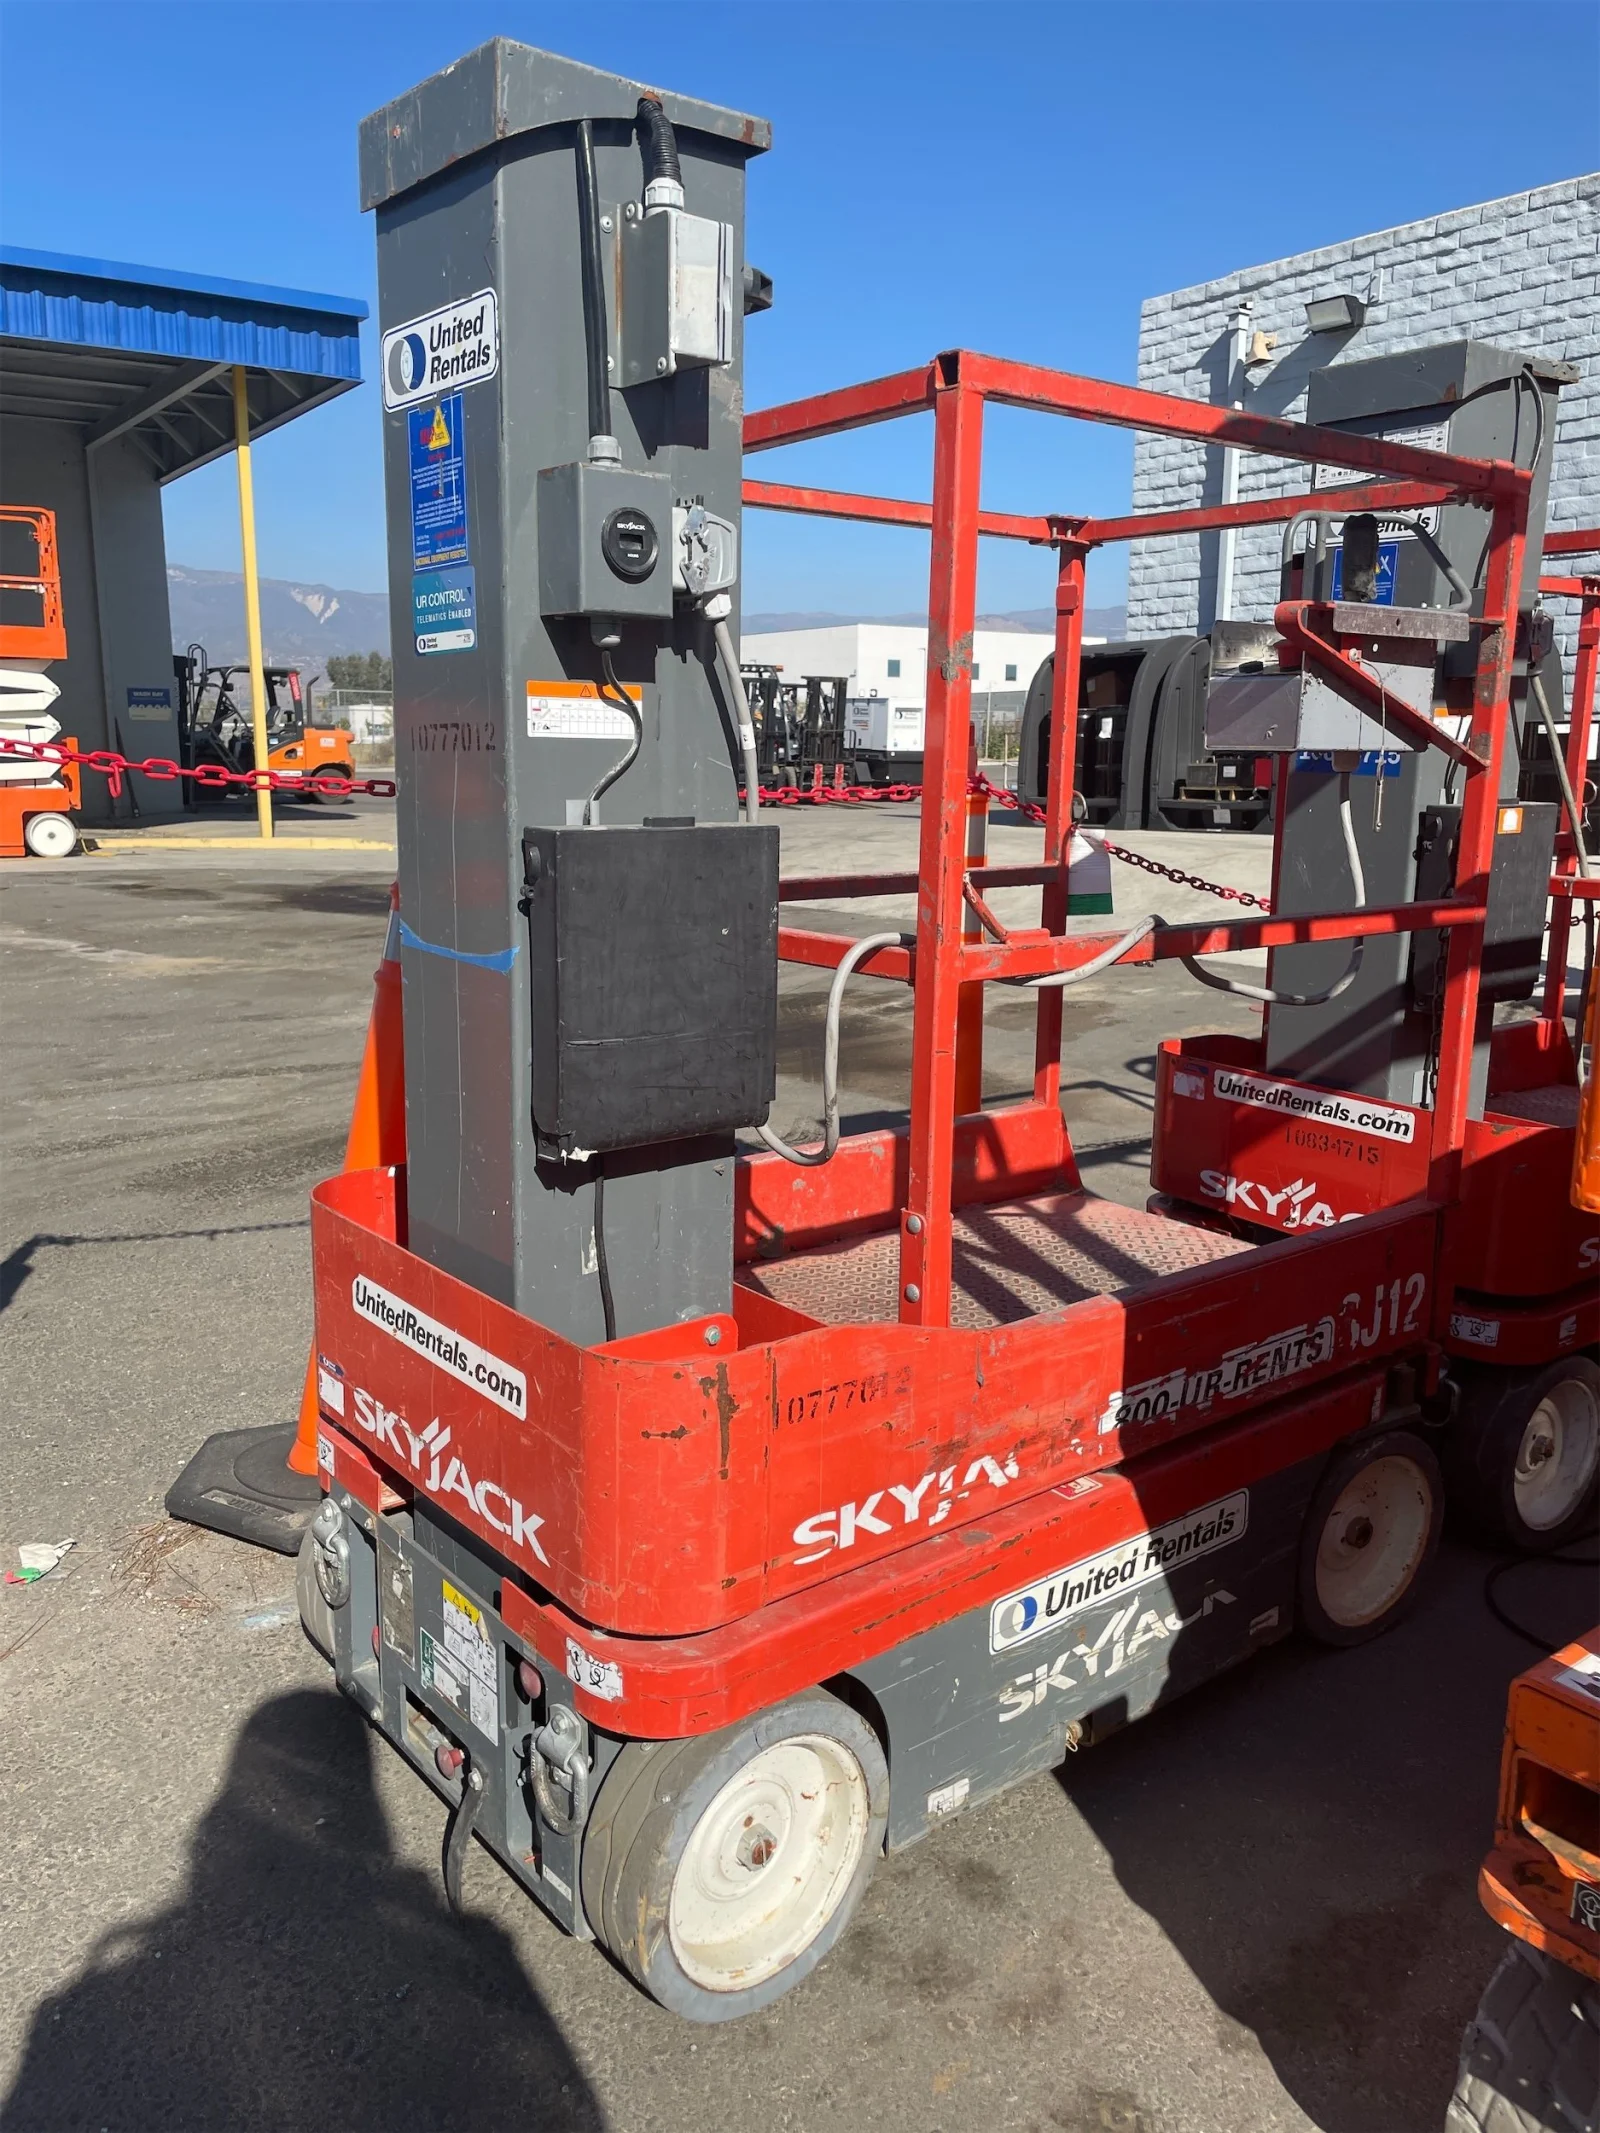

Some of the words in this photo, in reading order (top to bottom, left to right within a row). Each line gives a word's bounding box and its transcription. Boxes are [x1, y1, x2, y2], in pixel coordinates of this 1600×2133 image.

[429, 306, 485, 353] United
[430, 343, 491, 384] Rentals
[616, 522, 646, 531] SKYJACK
[416, 595, 428, 609] UR
[428, 588, 466, 607] CONTROL
[416, 612, 447, 624] TELEMATICS
[448, 608, 472, 620] ENABLED
[411, 722, 496, 752] 10777012
[1218, 1075, 1411, 1137] UnitedRentals.com
[1286, 1126, 1380, 1165] 10834715
[355, 1280, 523, 1408] UnitedRentals.com
[353, 1386, 551, 1568] SKYJACK
[1045, 1551, 1139, 1618] United
[1143, 1507, 1237, 1571] Rentals
